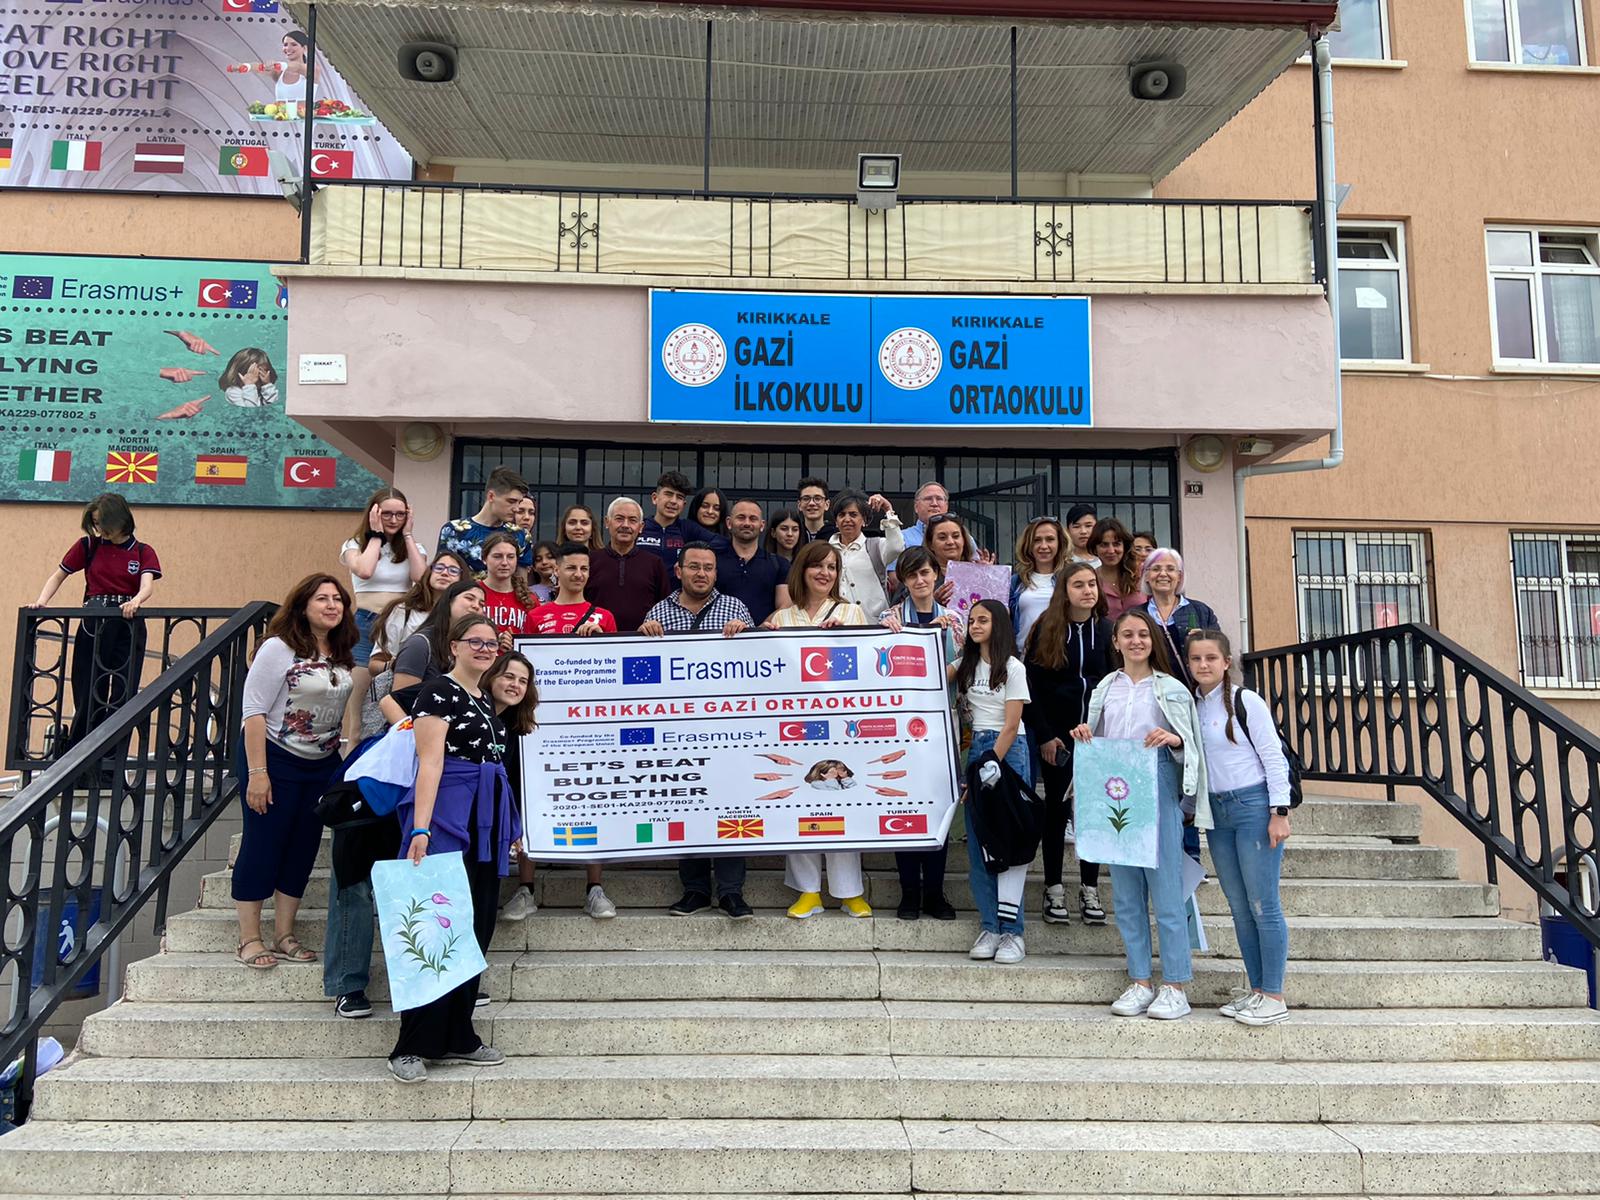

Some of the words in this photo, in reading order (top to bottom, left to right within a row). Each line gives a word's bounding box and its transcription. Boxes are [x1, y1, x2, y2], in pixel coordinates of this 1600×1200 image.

[0, 24, 53, 45] AT
[63, 26, 176, 49] RIGHT
[79, 52, 183, 74] RIGHT
[66, 76, 180, 99] RIGHT
[146, 135, 176, 143] LATVIA
[224, 138, 267, 147] PORTUGAL
[314, 141, 346, 149] TURKEY
[61, 278, 183, 301] Erasmus+
[737, 311, 831, 325] KIRIKKALE
[951, 315, 1044, 329] KIRIKKALE
[25, 329, 113, 346] BEAT
[734, 330, 794, 367] GAZİ
[949, 333, 1008, 370] GAZİ
[734, 374, 863, 413] İLKOKULU
[949, 384, 1083, 415] ORTAOKULU
[119, 436, 149, 444] NORTH
[107, 445, 159, 453] MACEDONIA
[294, 448, 328, 456] TURKEY
[554, 658, 592, 666] Co-funded
[593, 658, 603, 666] by
[670, 656, 787, 681] Erasmus+
[574, 668, 617, 676] Programme
[558, 679, 593, 687] European
[595, 677, 617, 685] Union
[567, 702, 695, 717] KIRIKKALE
[703, 697, 757, 713] GAZİ
[765, 694, 903, 711] ORTAOKULU
[662, 730, 767, 743] Erasmus+
[544, 760, 625, 772] LET'S
[636, 757, 711, 769] BEAT
[553, 772, 702, 787] BULLYING
[547, 787, 709, 802] TOGETHER
